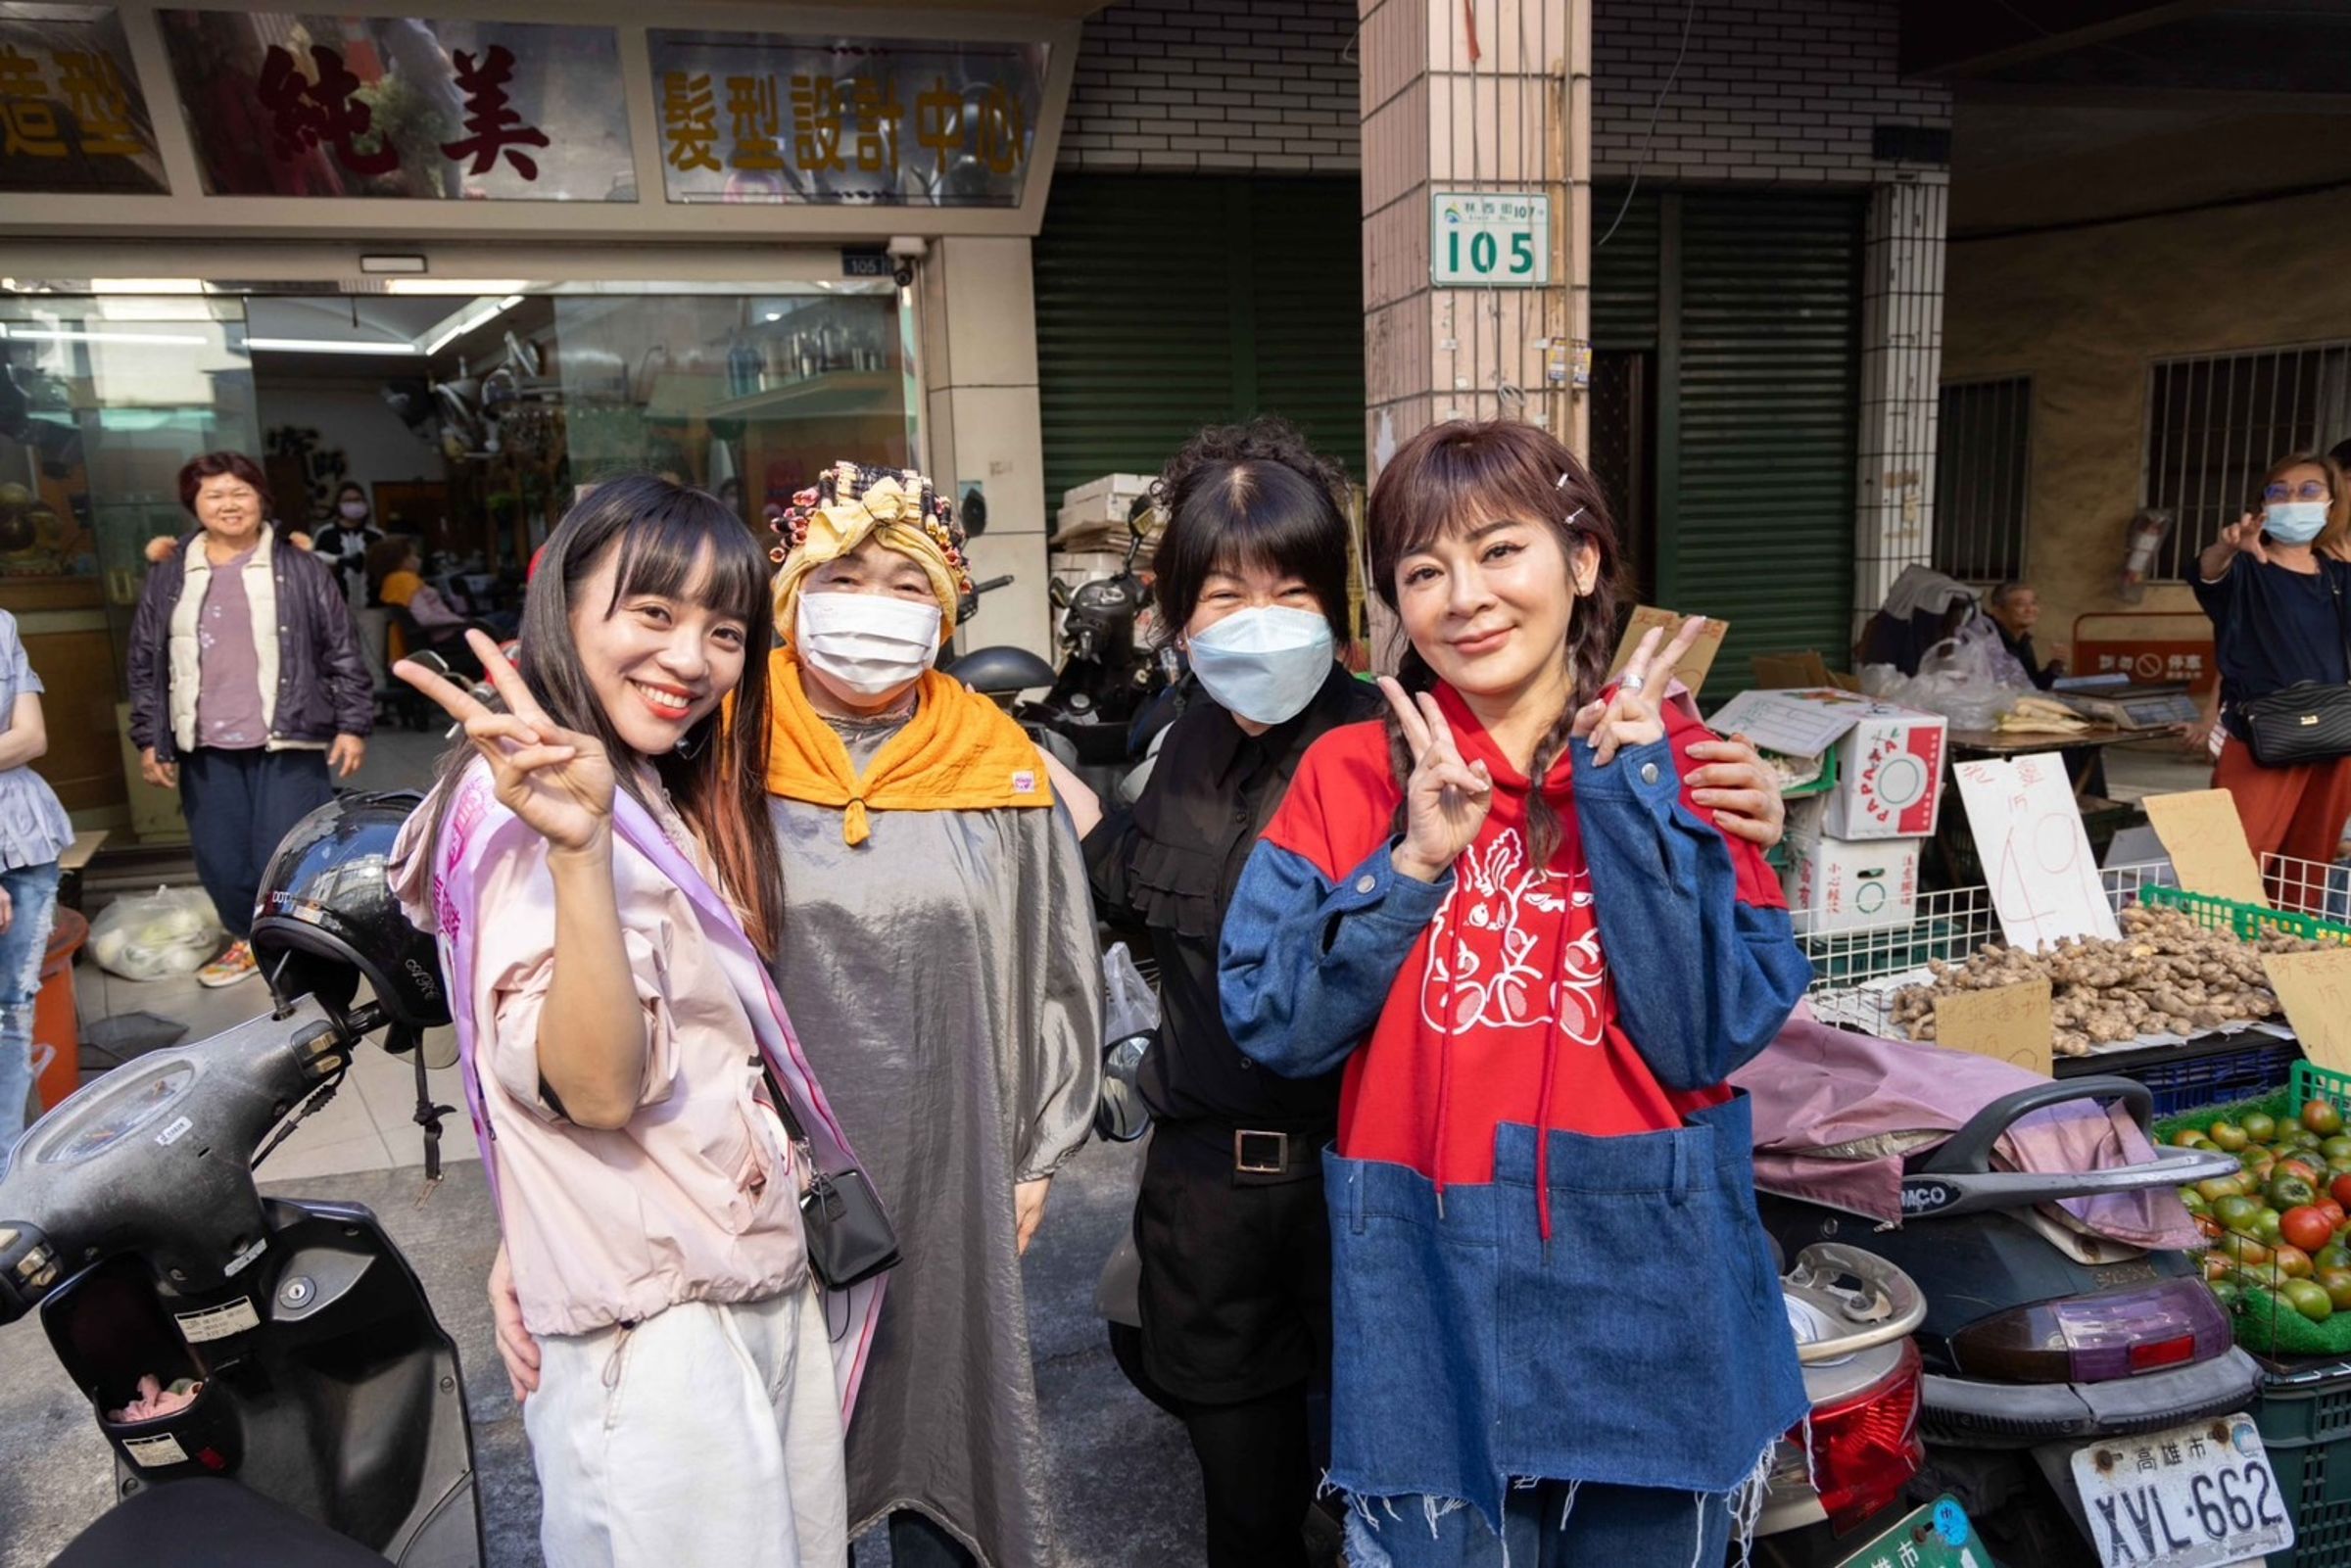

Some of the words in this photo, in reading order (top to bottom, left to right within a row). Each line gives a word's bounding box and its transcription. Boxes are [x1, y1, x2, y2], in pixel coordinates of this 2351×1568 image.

[0, 44, 144, 157] 造型
[260, 45, 551, 180] 純美
[663, 72, 1025, 174] 髮型設計中心
[1449, 231, 1534, 273] 105
[2137, 1437, 2207, 1473] 高雄市
